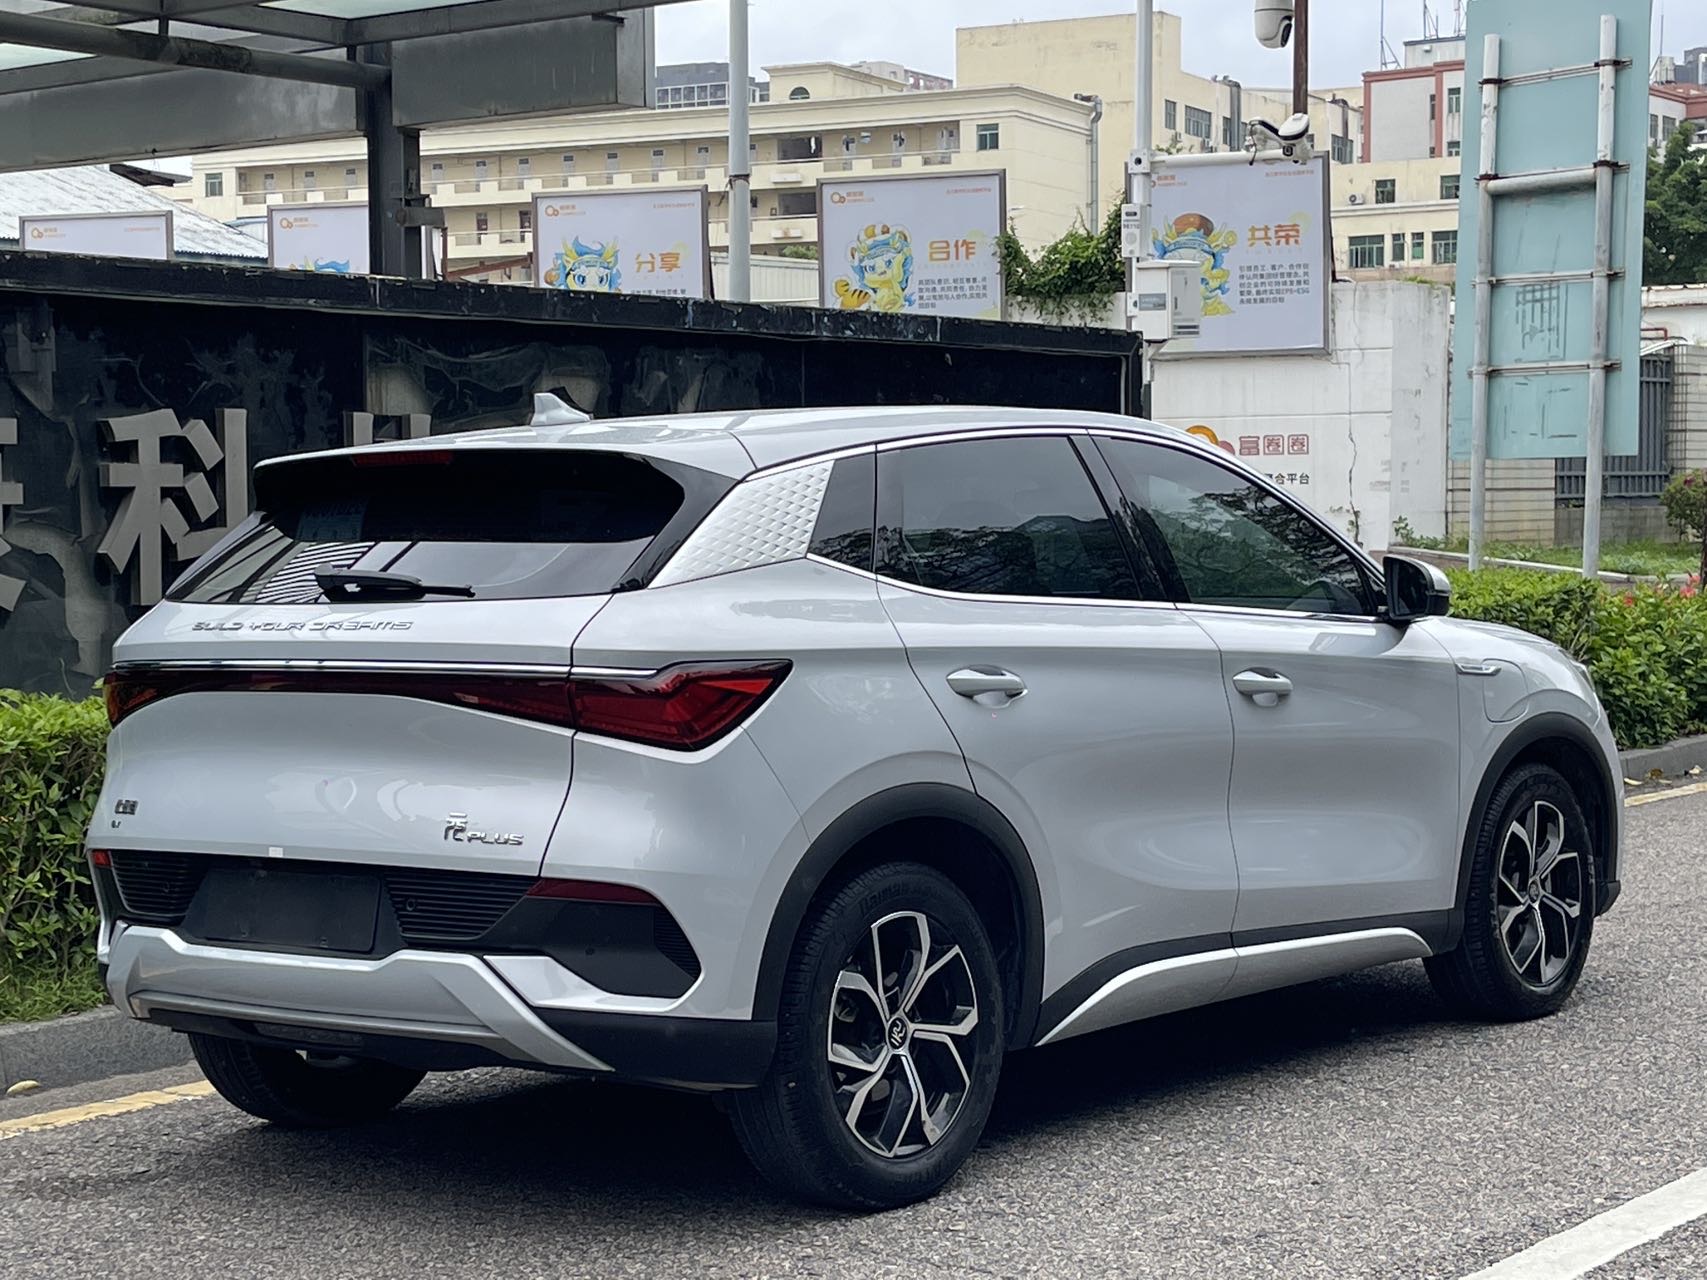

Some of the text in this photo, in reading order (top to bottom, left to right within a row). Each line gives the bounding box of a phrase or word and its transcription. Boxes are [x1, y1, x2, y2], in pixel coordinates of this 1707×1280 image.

[1248, 224, 1300, 247] 共荣
[929, 239, 976, 261] 合作
[635, 252, 681, 273] 分享
[1265, 472, 1310, 485] 合平台
[250, 621, 305, 631] YOUR
[309, 621, 414, 631] DREAMS
[443, 812, 524, 845] 元 PLUS
